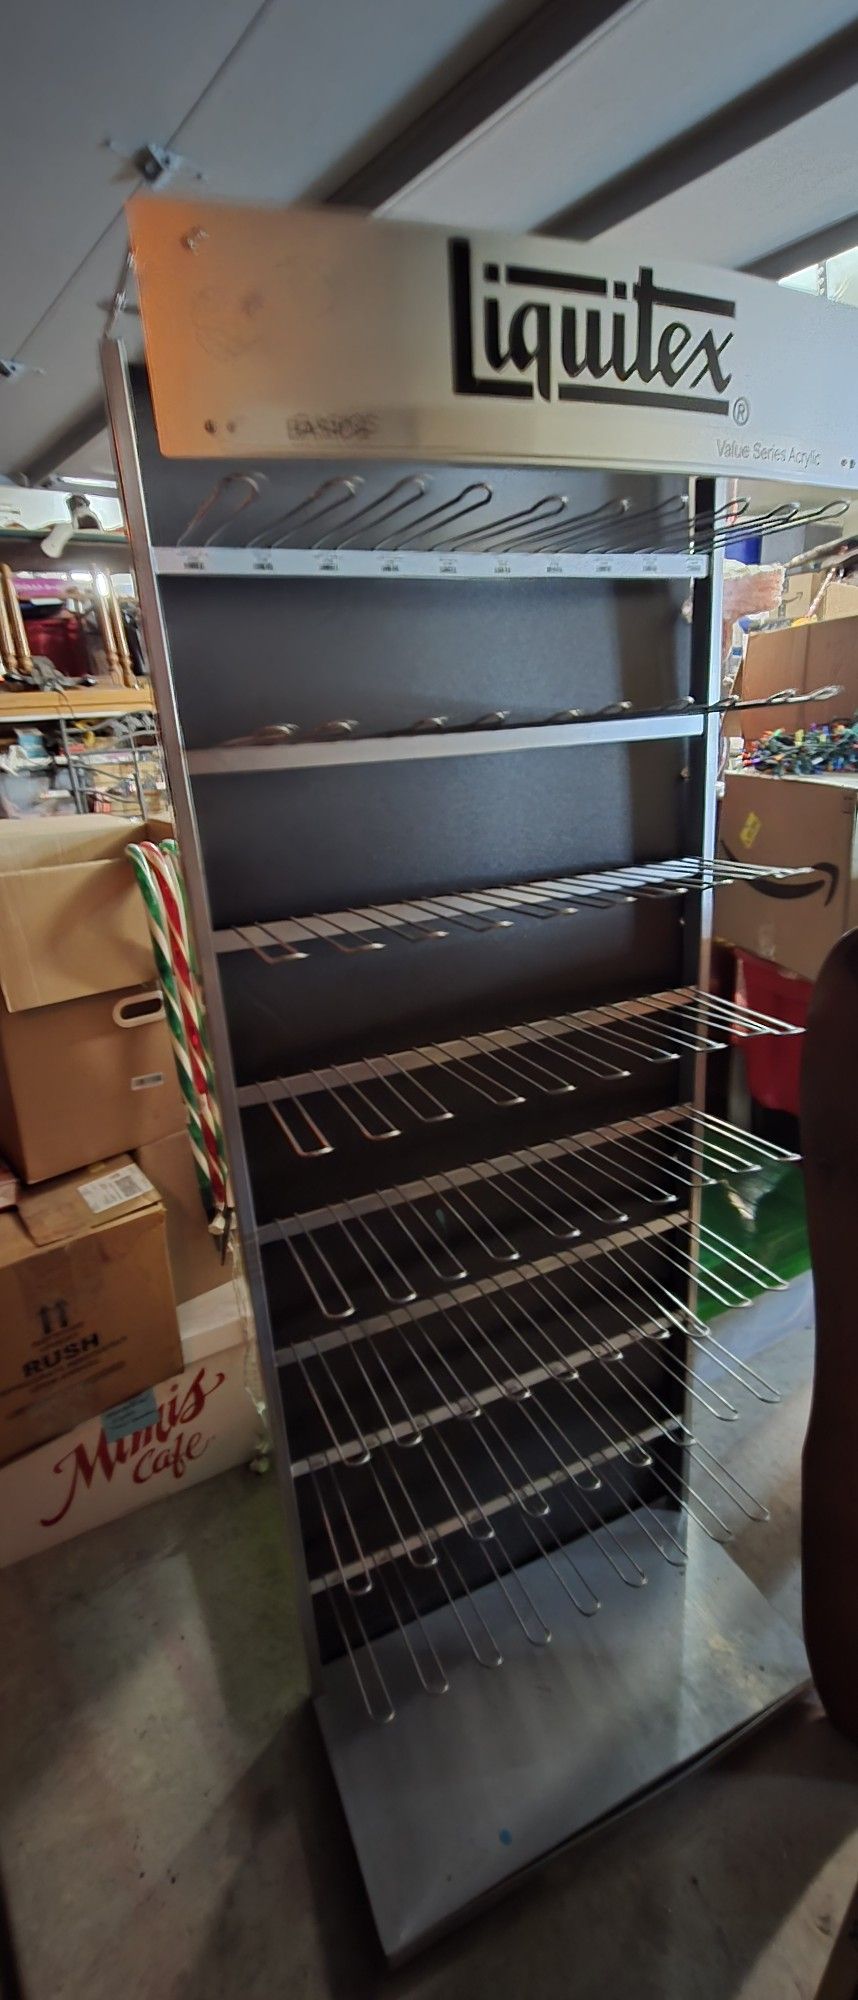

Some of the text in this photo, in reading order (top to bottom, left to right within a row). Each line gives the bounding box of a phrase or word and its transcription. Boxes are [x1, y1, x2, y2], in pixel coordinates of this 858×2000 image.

[450, 238, 737, 416] Liquitex
[716, 440, 821, 468] Value Series Acrylic
[22, 1332, 99, 1377] RUSH
